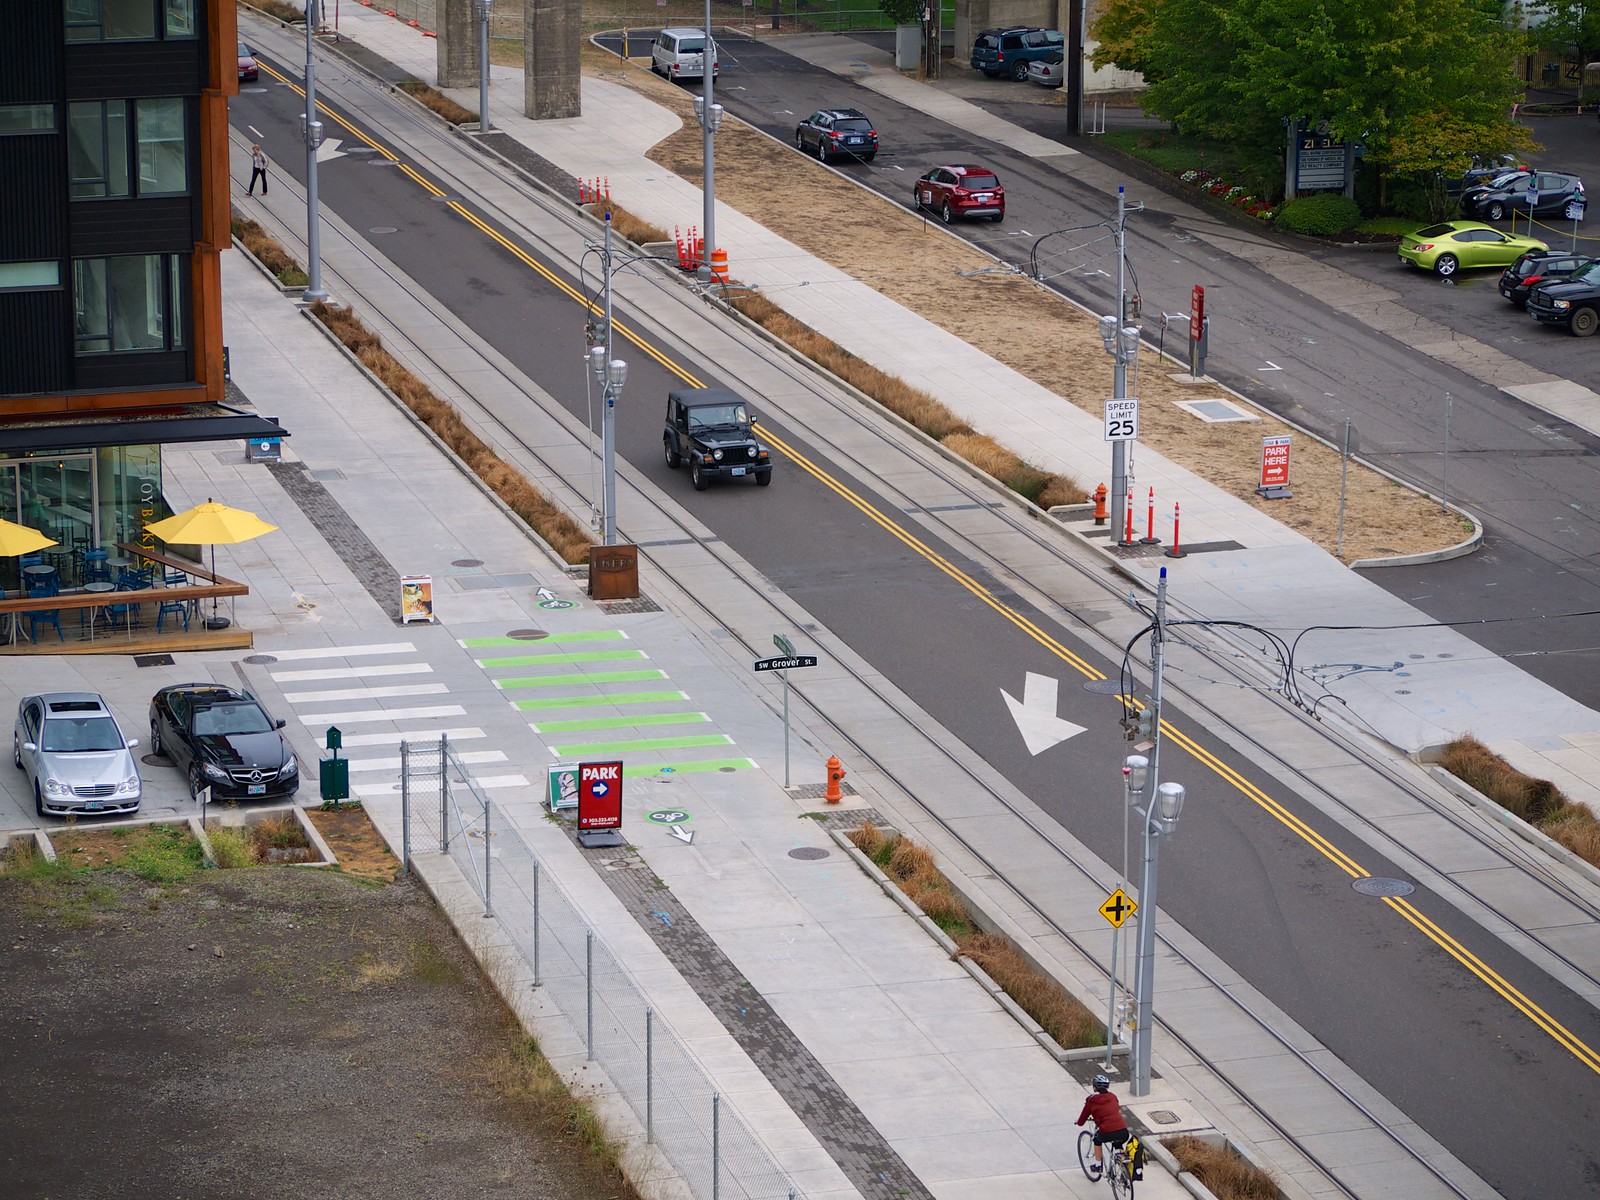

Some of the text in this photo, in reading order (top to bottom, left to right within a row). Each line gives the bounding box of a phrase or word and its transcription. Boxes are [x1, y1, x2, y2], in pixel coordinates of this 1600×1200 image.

[1108, 402, 1136, 411] SPEED
[1110, 411, 1133, 419] LIMIT
[1108, 420, 1134, 437] 25
[1265, 446, 1288, 456] PARK
[1264, 456, 1287, 466] HERE
[771, 658, 800, 668] Grover
[804, 658, 813, 666] St.
[582, 766, 619, 780] PARK
